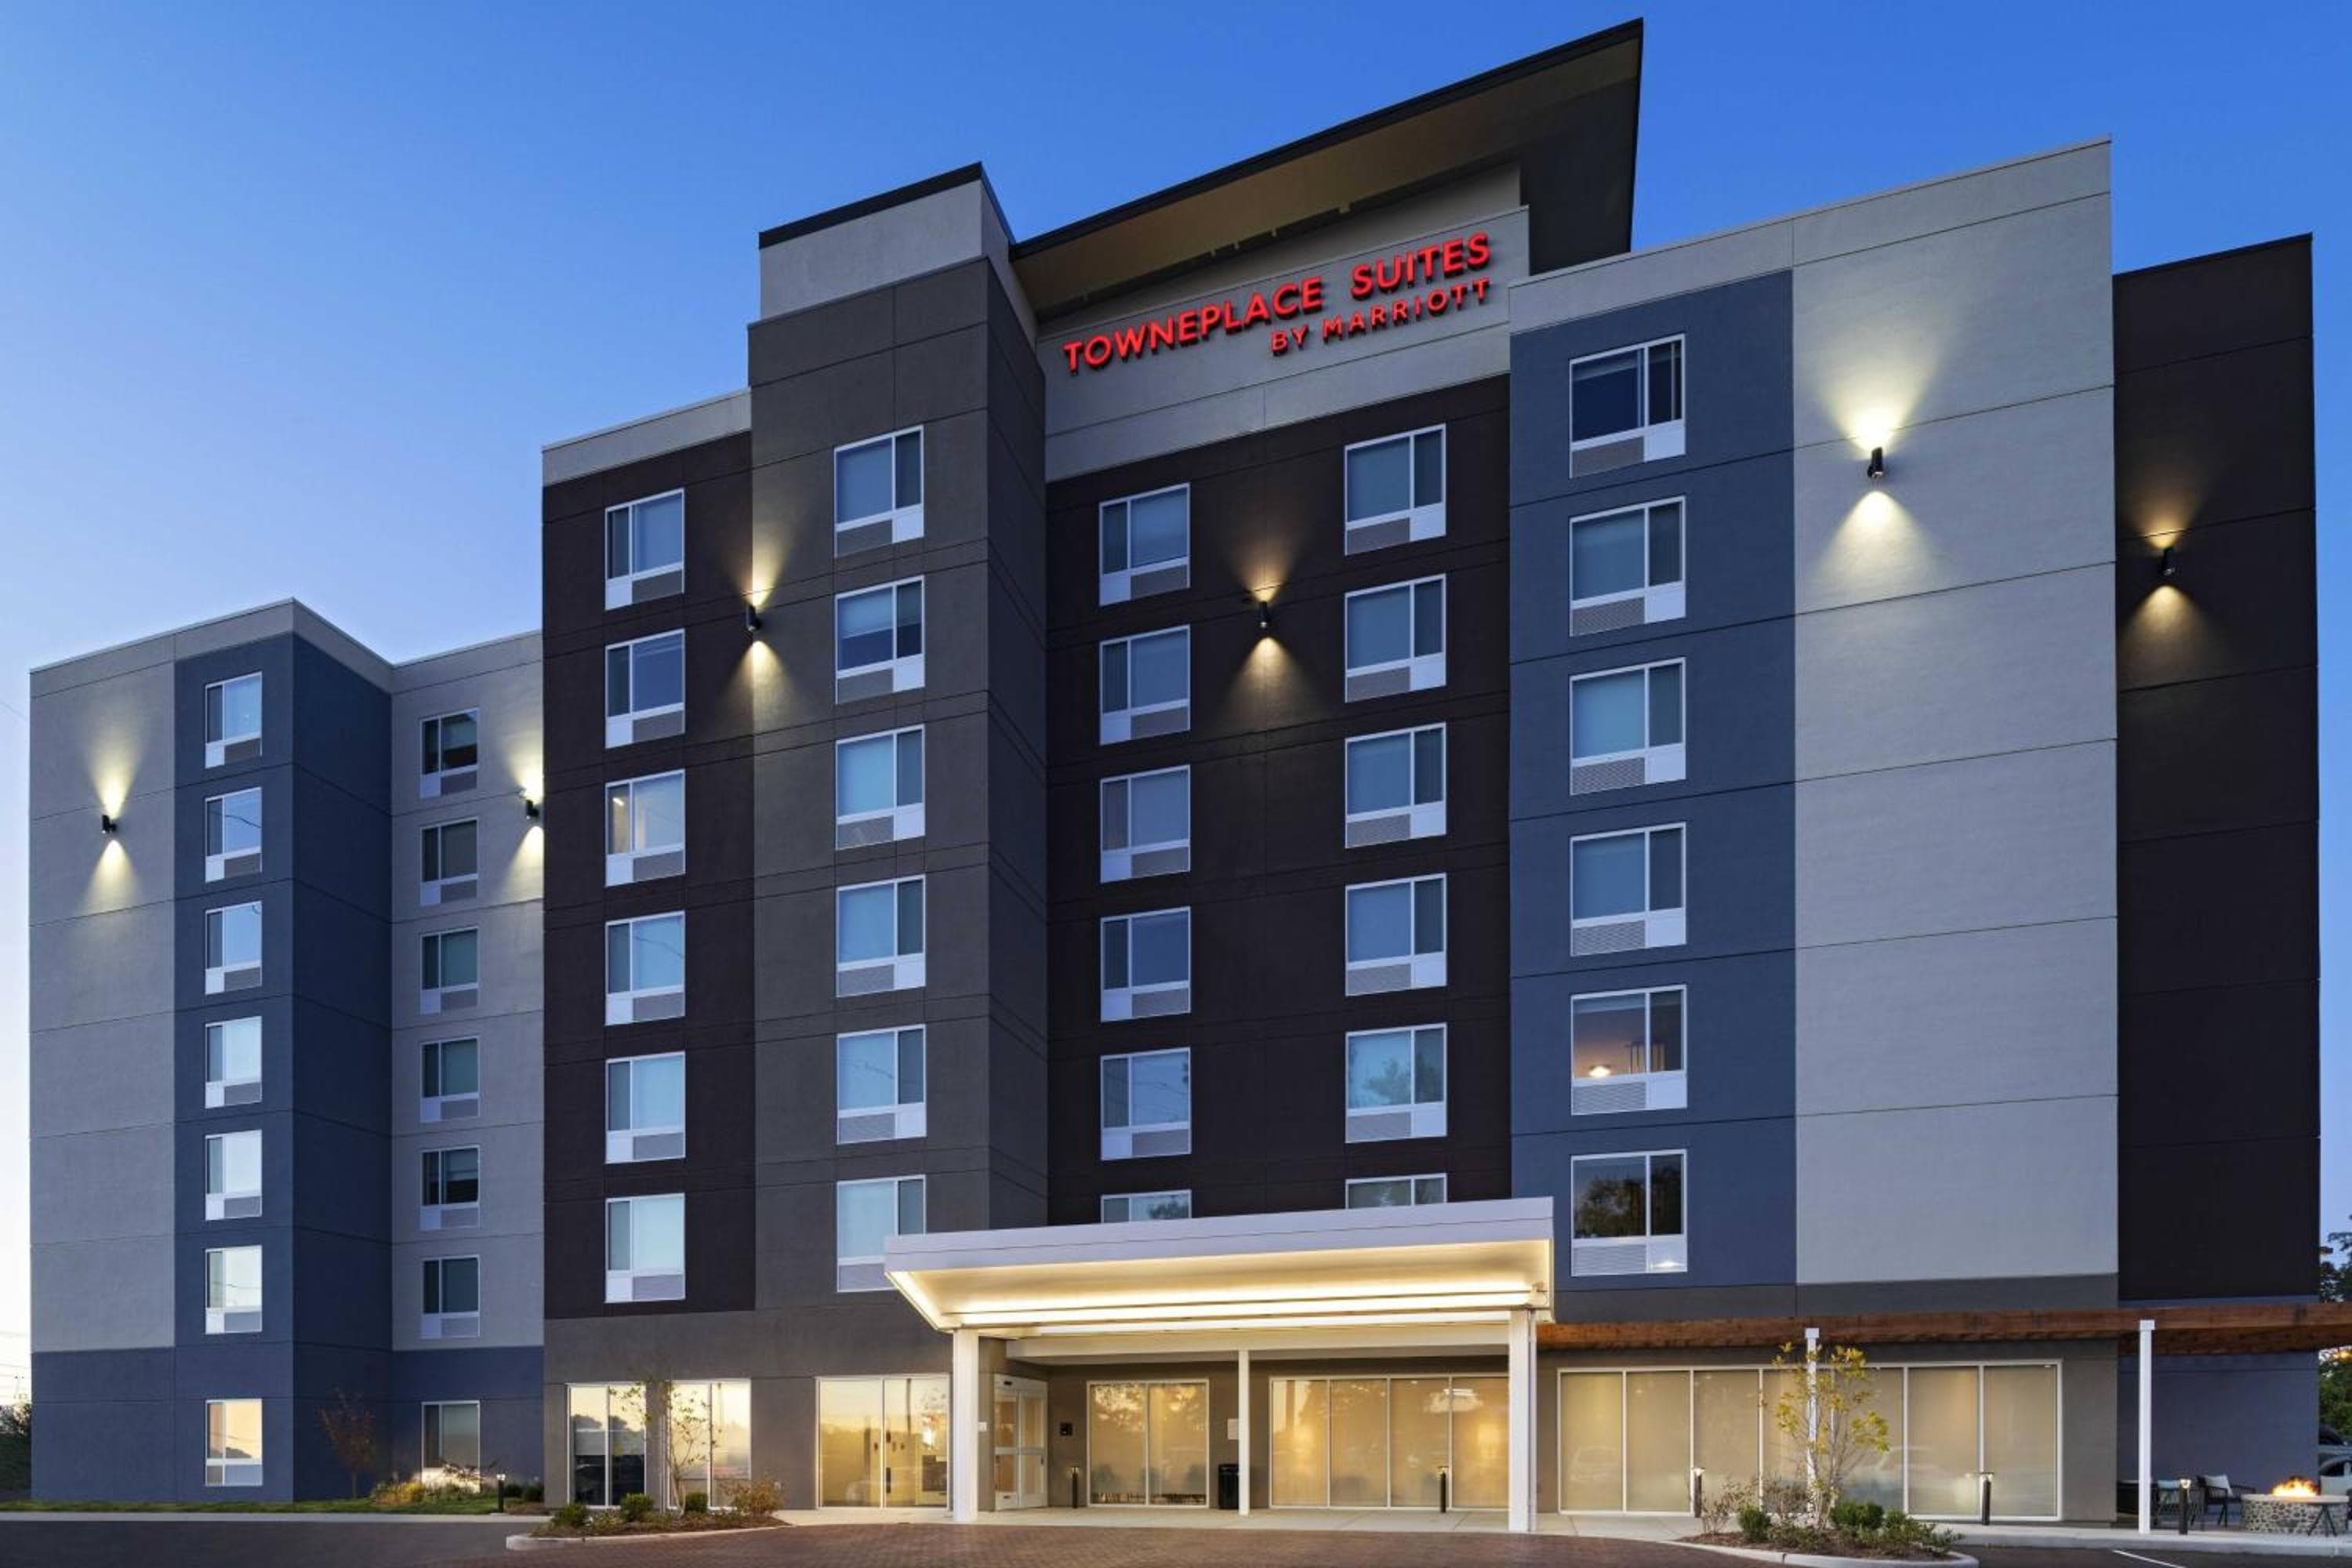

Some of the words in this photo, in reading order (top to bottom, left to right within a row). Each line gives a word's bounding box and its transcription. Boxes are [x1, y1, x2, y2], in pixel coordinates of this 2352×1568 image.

[1063, 277, 1324, 374] TOWNEPLACE
[1351, 232, 1492, 297] SUITES
[1271, 325, 1308, 354] BY
[1322, 278, 1489, 339] MARRIOTT
